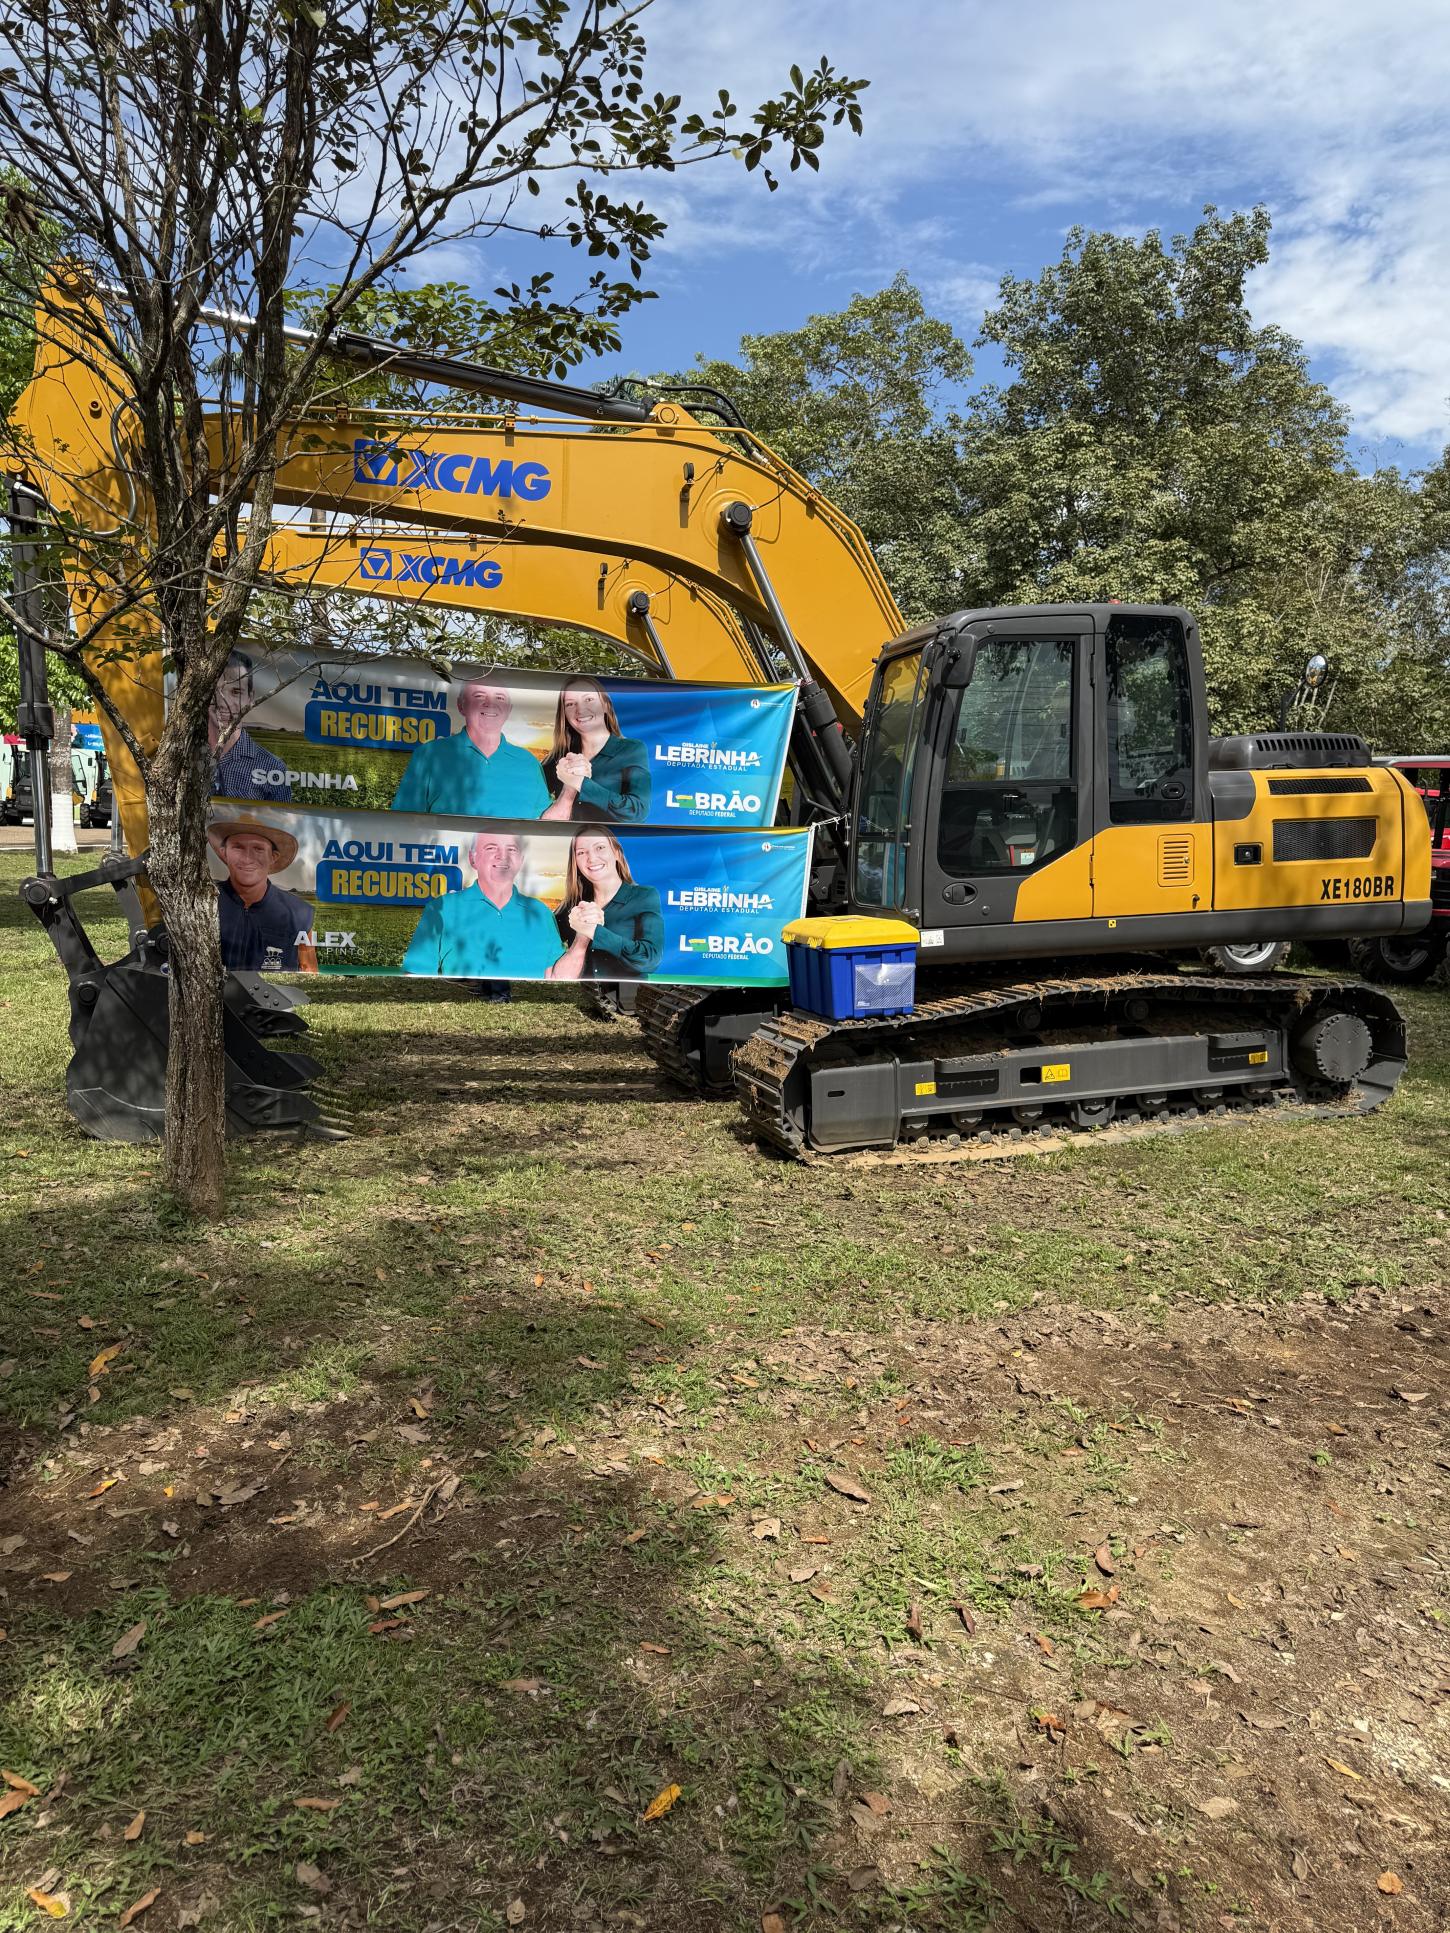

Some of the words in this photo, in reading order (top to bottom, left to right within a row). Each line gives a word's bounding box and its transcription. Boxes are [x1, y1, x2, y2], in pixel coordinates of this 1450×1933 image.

[399, 450, 551, 501] XCMG
[394, 554, 502, 589] XCMG
[311, 680, 381, 704] AQUI
[388, 687, 447, 710] TEM
[320, 710, 435, 744] RECURSO
[656, 745, 761, 767] LEBRINHA
[667, 761, 705, 769] DEPUTADA
[709, 763, 747, 771] ESTADUAL
[251, 769, 358, 791] SOPINHA
[322, 840, 393, 862] AQUI
[399, 843, 459, 864] TEM
[332, 870, 447, 899] RECURSO
[1321, 876, 1394, 900] XE180BR
[668, 891, 773, 909] LEBRINHA
[294, 930, 356, 948] ALEX
[327, 946, 365, 956] PINTO
